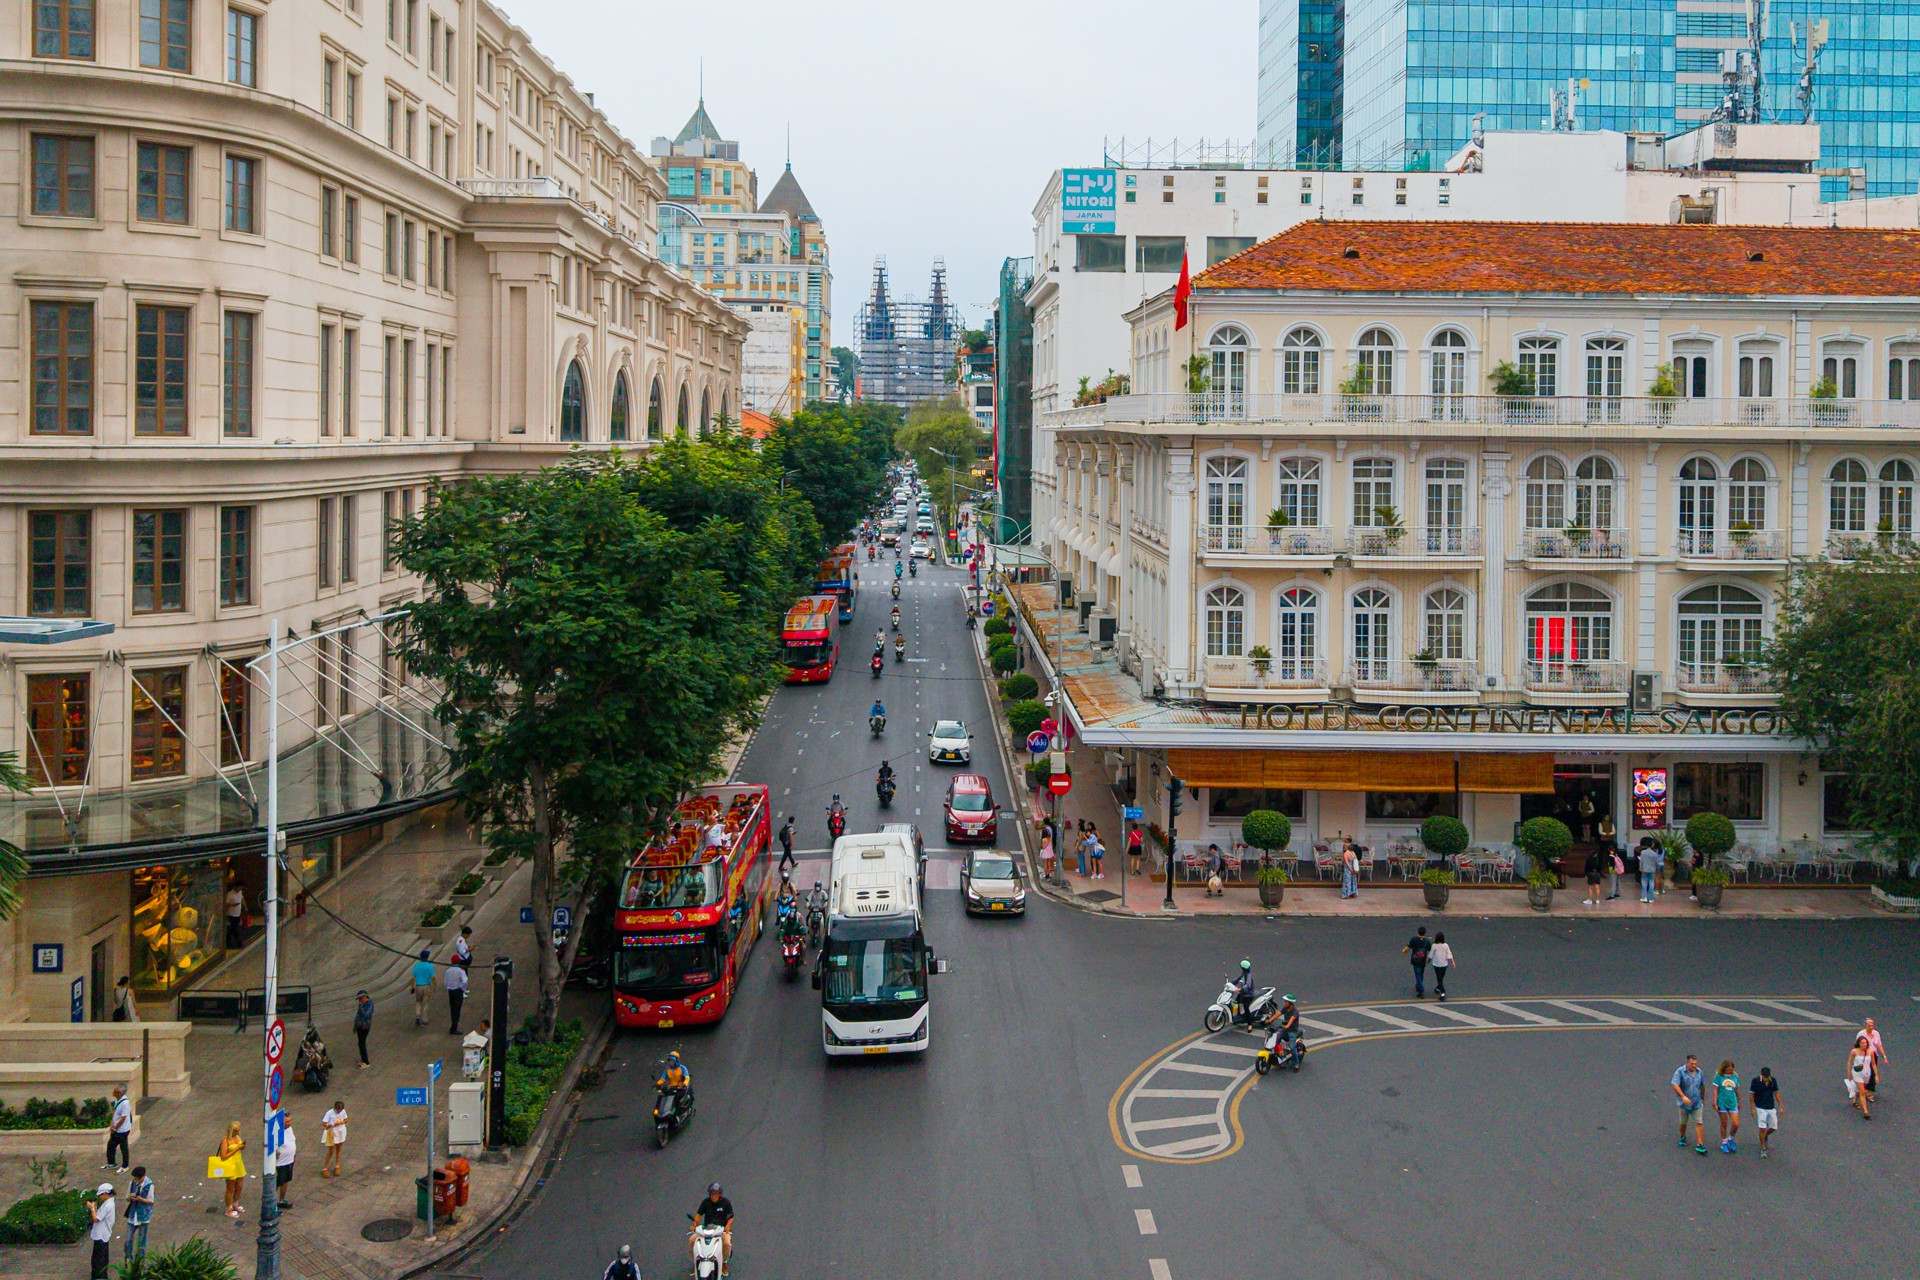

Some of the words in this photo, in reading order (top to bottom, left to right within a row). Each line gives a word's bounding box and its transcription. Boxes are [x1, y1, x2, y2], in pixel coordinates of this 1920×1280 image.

[1065, 174, 1113, 193] ニトリ
[1065, 196, 1113, 207] NITORI
[1082, 223, 1096, 233] 4F
[1240, 704, 1360, 731] HOTEL
[1378, 705, 1641, 734] CONTINENTAL
[1028, 735, 1048, 747] Vikki
